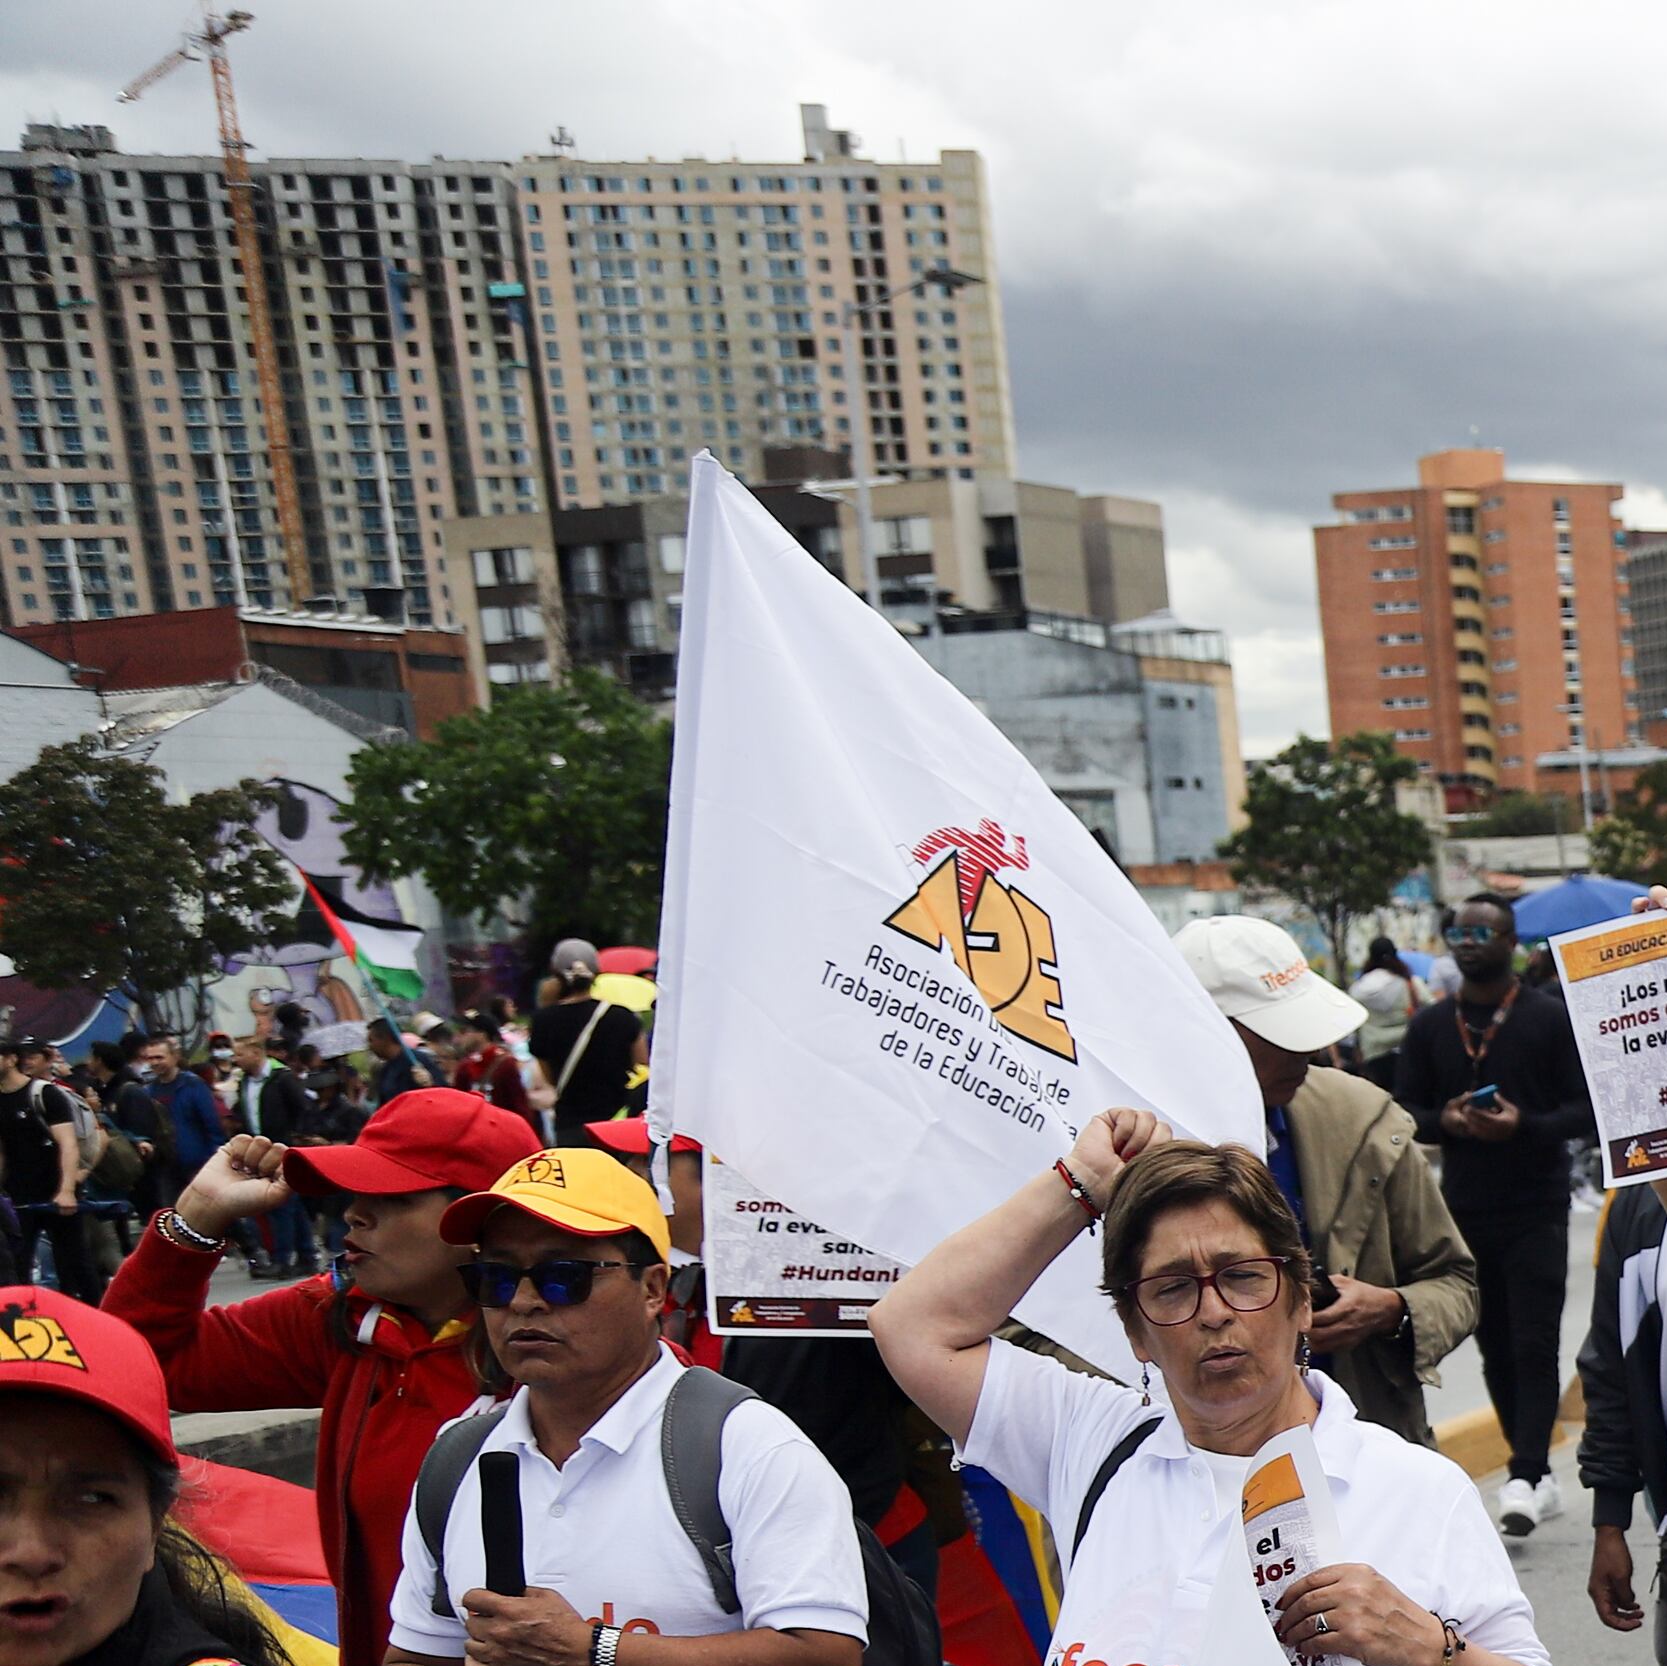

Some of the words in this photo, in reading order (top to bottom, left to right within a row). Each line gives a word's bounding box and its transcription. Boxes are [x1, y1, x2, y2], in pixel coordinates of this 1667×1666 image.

[864, 943, 984, 1022] Asociación
[1620, 978, 1658, 1008] ¡Los
[820, 960, 964, 1047] Trabajadores
[964, 1037, 984, 1063] y
[1598, 1011, 1661, 1036] somos
[1621, 1034, 1641, 1055] la
[879, 1029, 909, 1059] de
[912, 1046, 933, 1070] la
[938, 1055, 1046, 1133] Educación
[736, 1199, 796, 1215] som
[757, 1217, 780, 1234] la
[780, 1264, 901, 1283] #HundanL
[1256, 1527, 1281, 1556] el
[1253, 1555, 1297, 1588] dos
